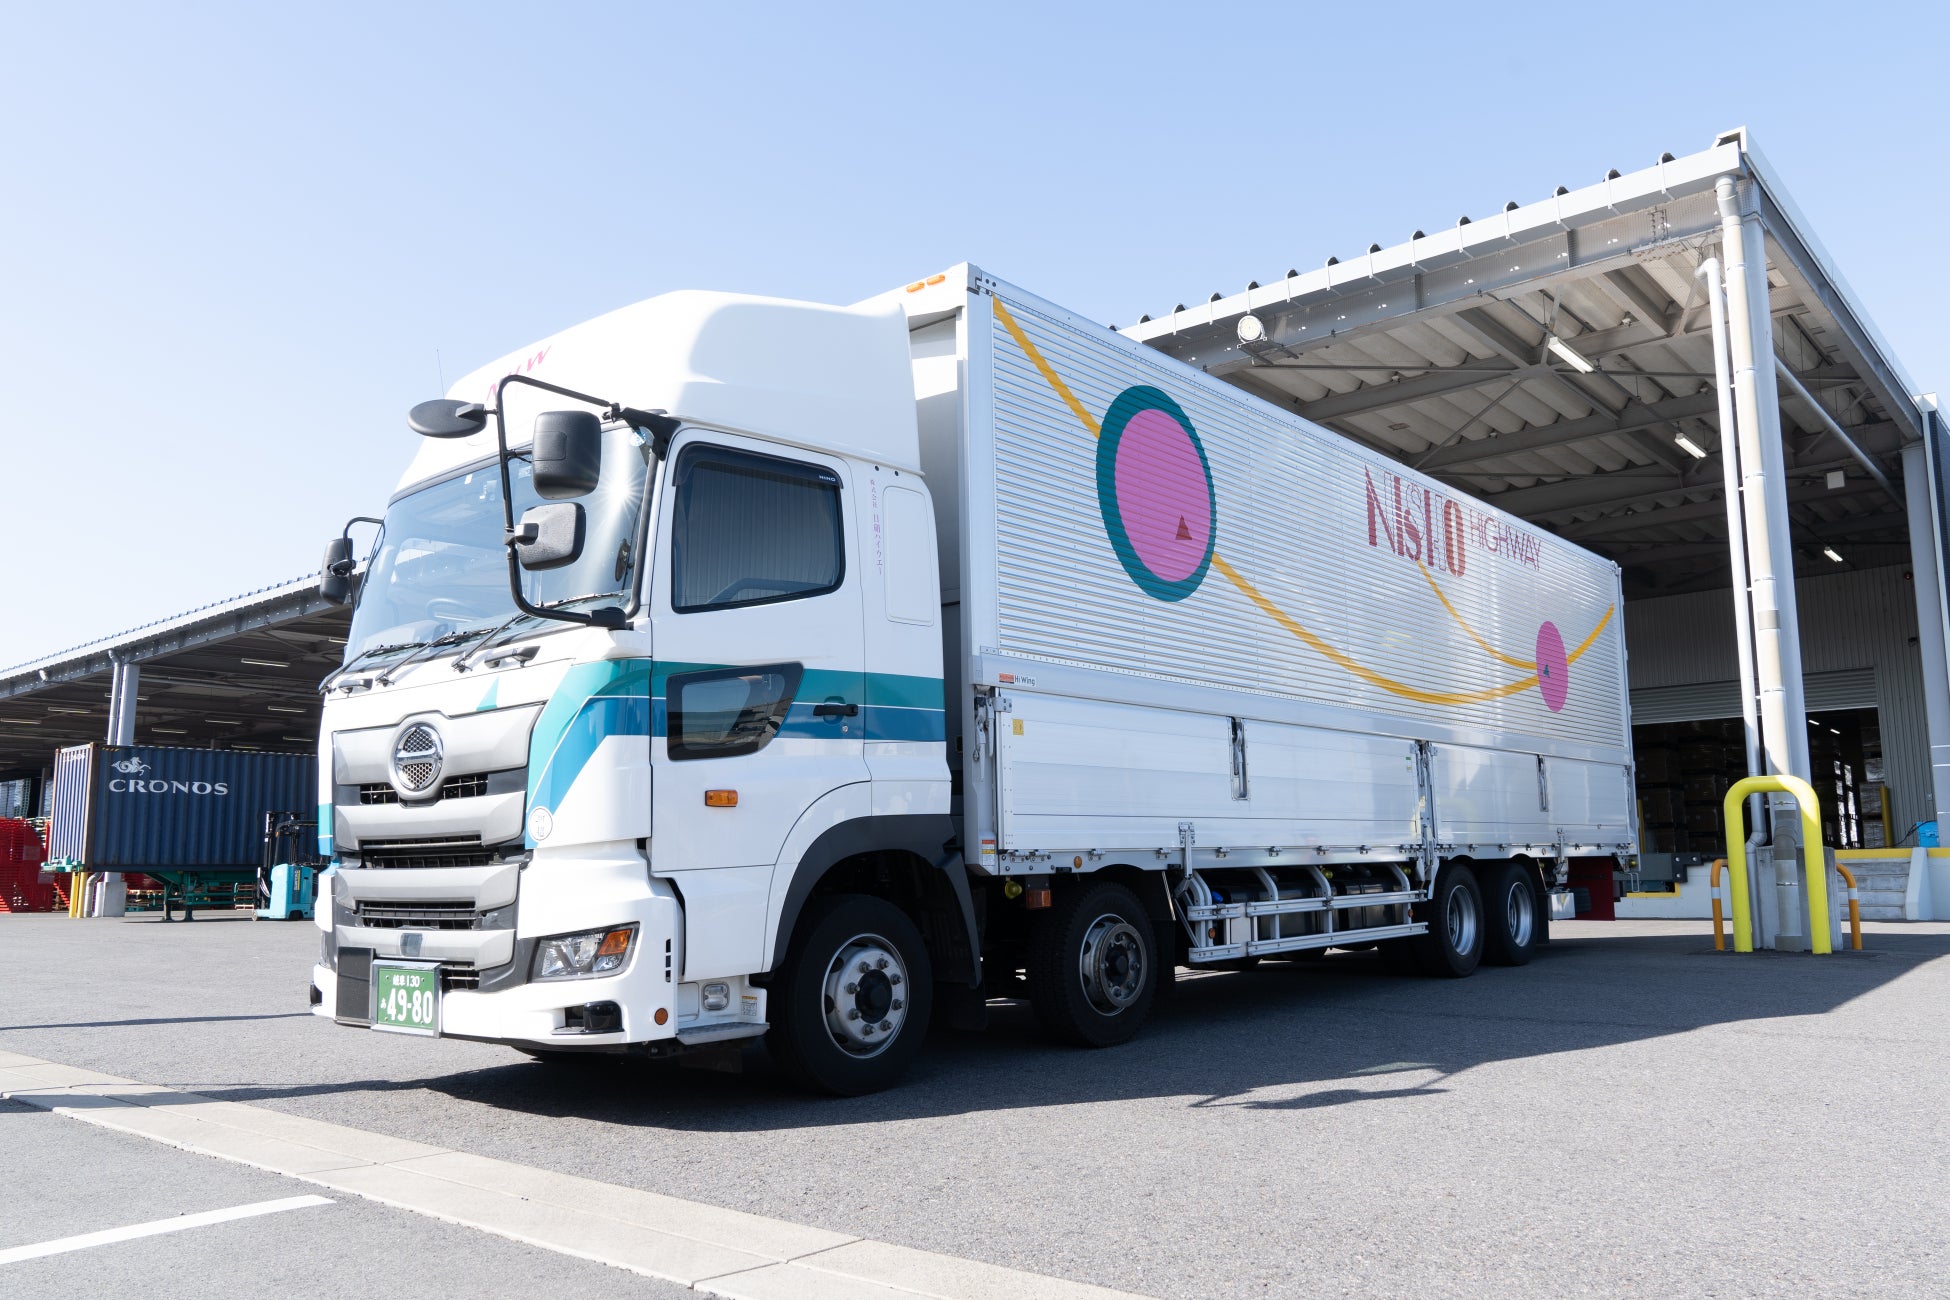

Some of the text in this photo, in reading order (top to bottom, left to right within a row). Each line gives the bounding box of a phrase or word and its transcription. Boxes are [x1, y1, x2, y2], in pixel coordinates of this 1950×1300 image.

[486, 345, 551, 402] NW
[1469, 509, 1542, 571] HIGHWAY
[108, 779, 229, 796] CRONOS
[407, 975, 420, 987] 130
[387, 988, 433, 1024] 49-80
